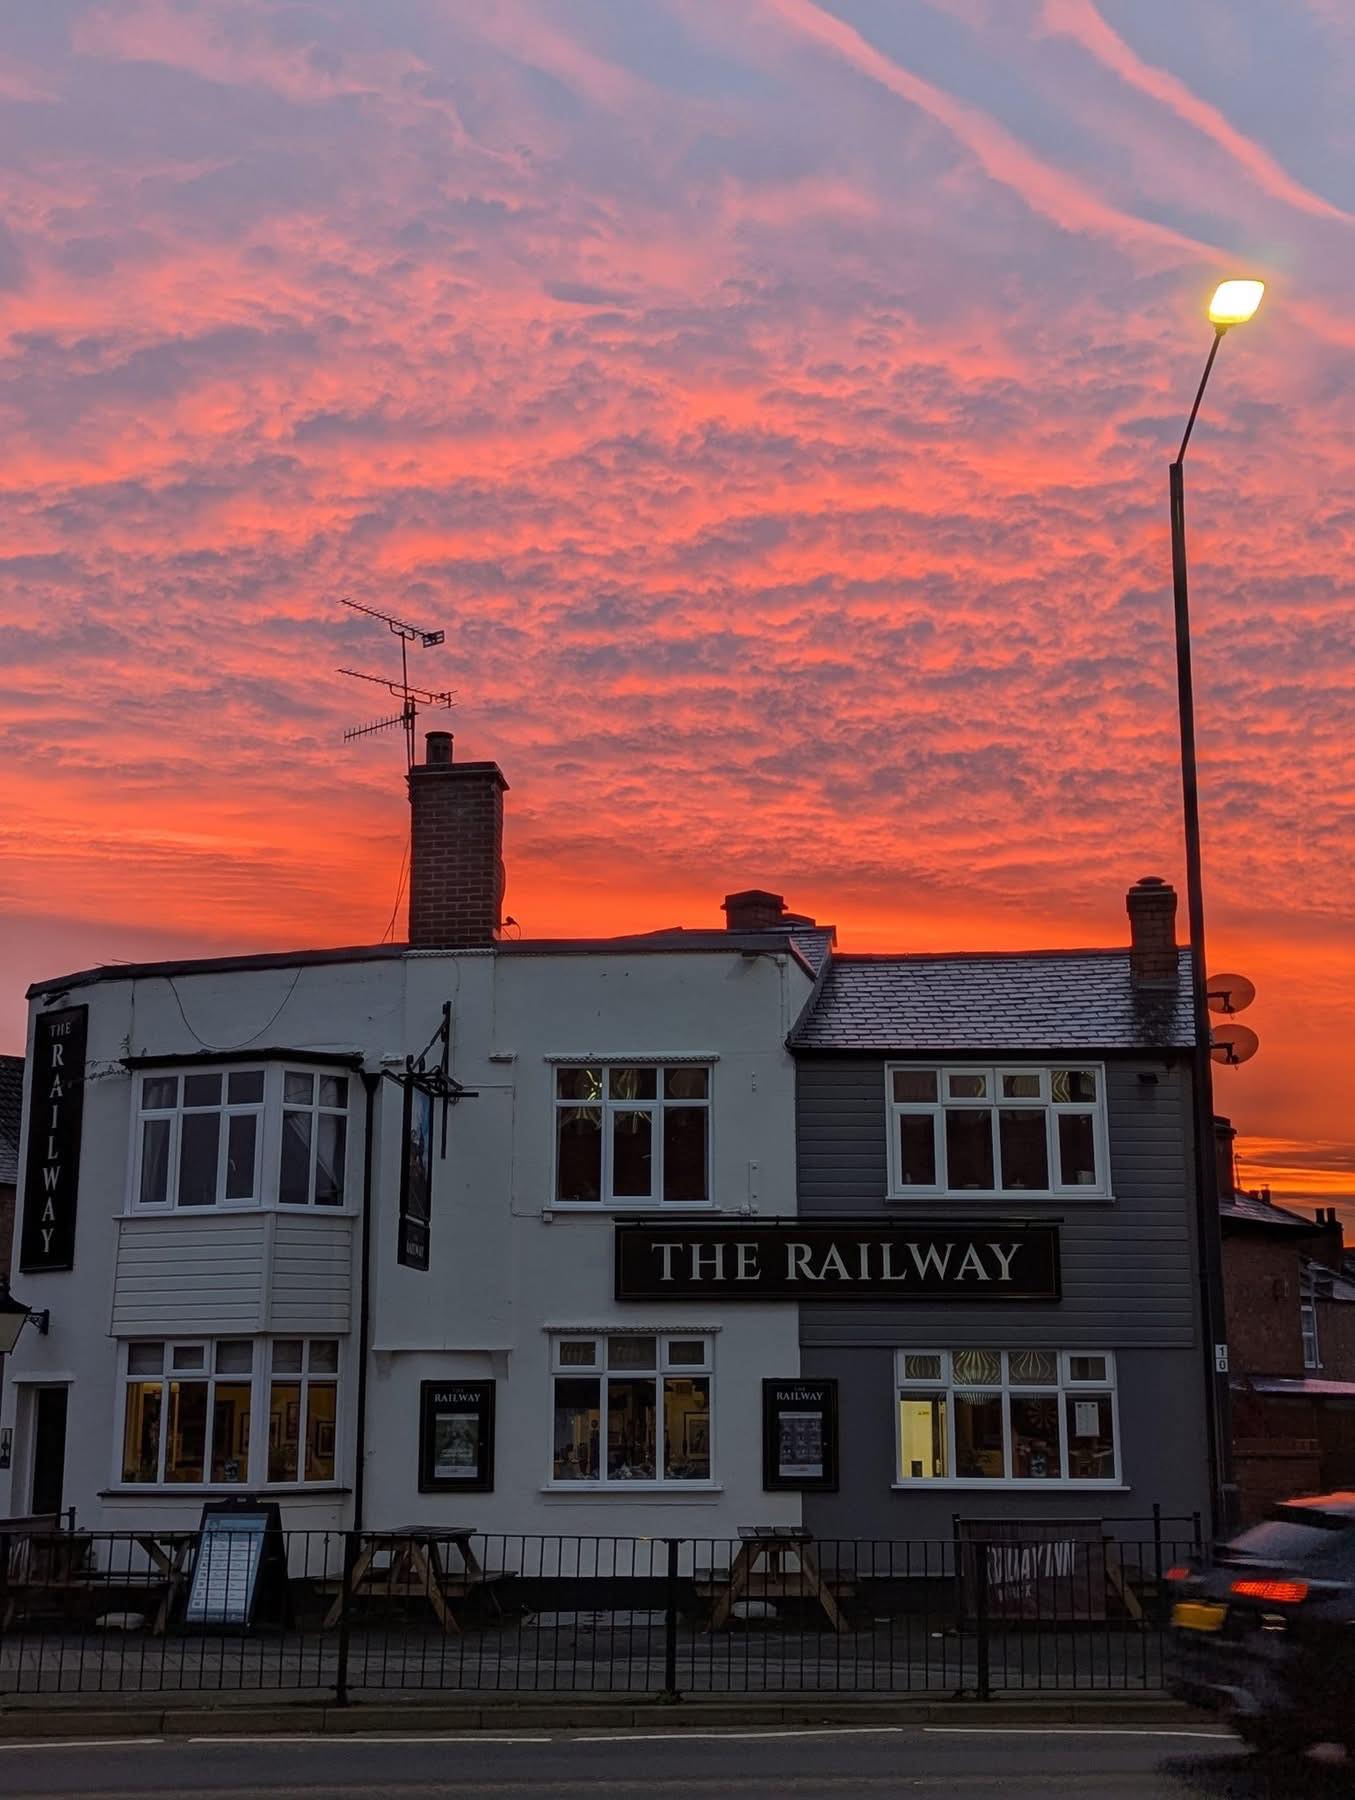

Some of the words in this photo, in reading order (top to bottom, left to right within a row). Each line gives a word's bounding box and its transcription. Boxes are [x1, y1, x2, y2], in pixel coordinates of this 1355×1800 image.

[50, 1022, 72, 1036] THE
[41, 1043, 65, 1253] RAILWAY
[651, 1243, 762, 1281] THE
[783, 1243, 1024, 1281] RAILWAY
[434, 1393, 481, 1402] RAILWAY
[776, 1391, 823, 1401] RAILWAY
